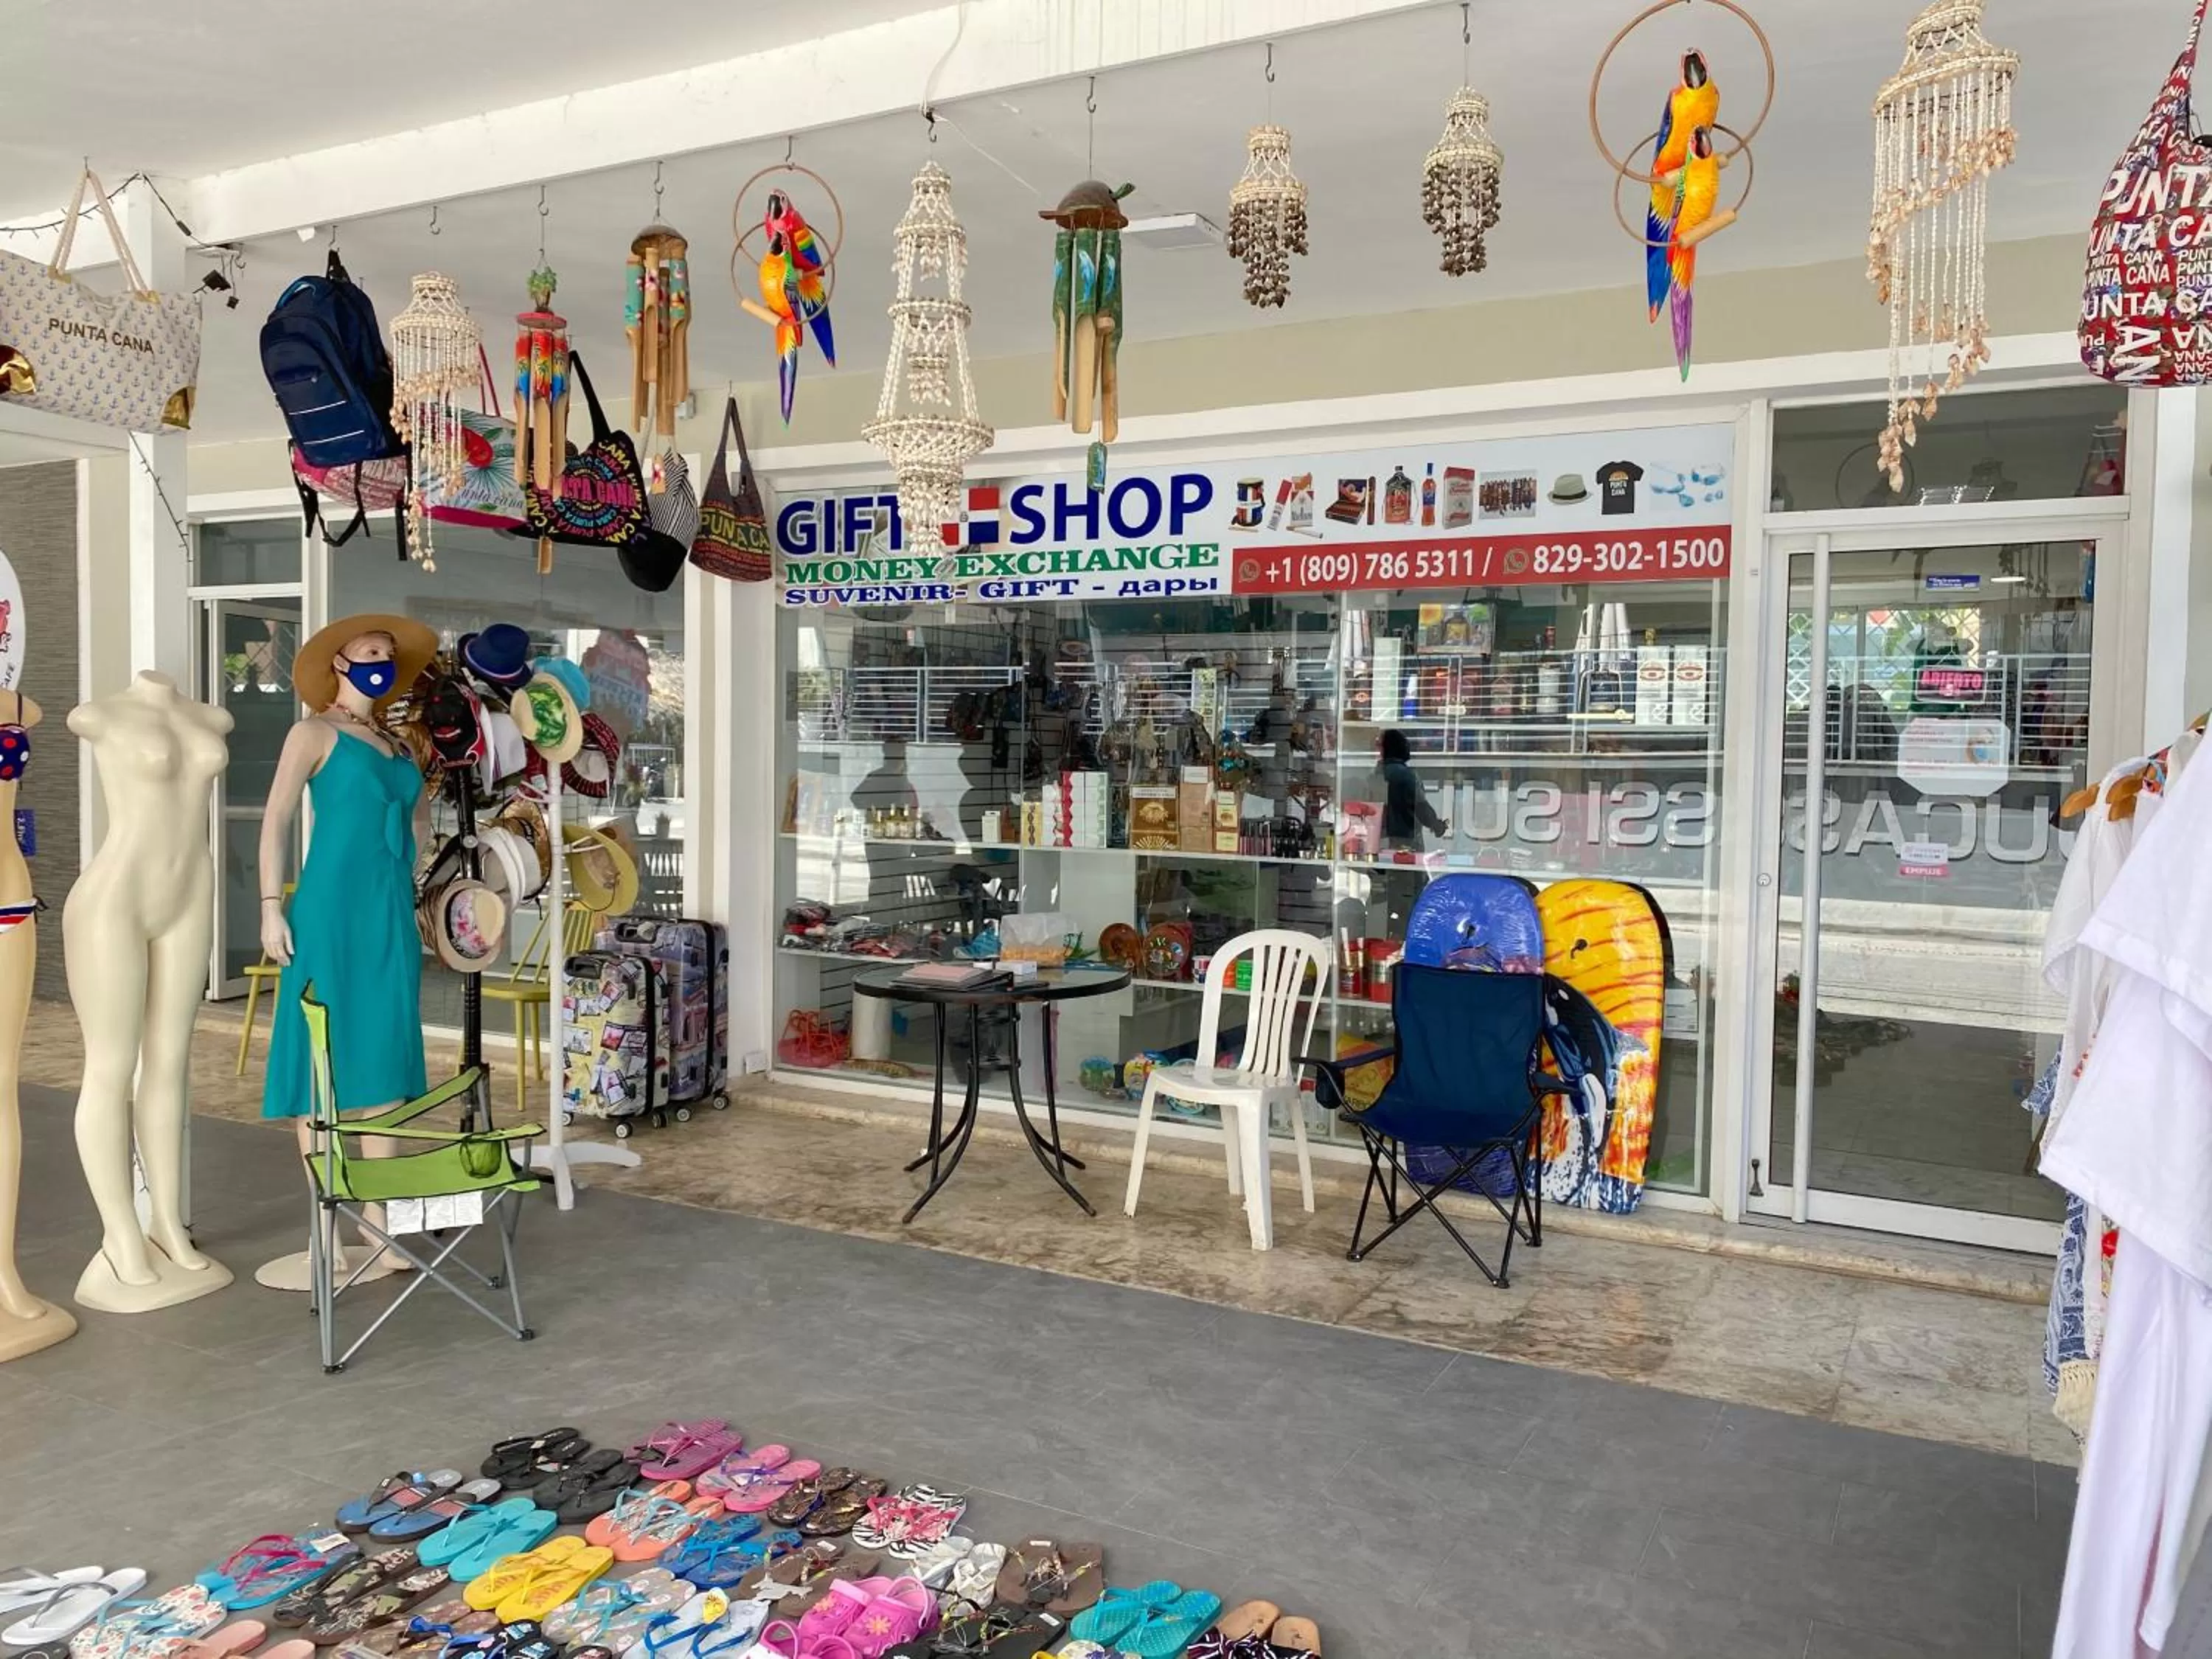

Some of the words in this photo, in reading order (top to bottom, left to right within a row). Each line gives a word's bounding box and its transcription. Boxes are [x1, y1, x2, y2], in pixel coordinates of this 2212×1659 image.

[2124, 251, 2163, 265] CANA
[2126, 264, 2170, 285] CANA
[48, 319, 108, 342] PUNTA
[112, 332, 154, 354] CANA
[776, 495, 902, 555] GIFT
[1009, 473, 1214, 546] SHOP
[785, 556, 952, 584] MONEY
[957, 543, 1220, 578] EXCHANGE
[1265, 554, 1291, 584] +1
[1300, 552, 1358, 586] (809)
[1365, 552, 1408, 581] 786
[1415, 548, 1474, 578] 5311
[1532, 538, 1724, 574] 829-302-1500
[981, 579, 1079, 599] GIFT
[1119, 577, 1218, 597] дары
